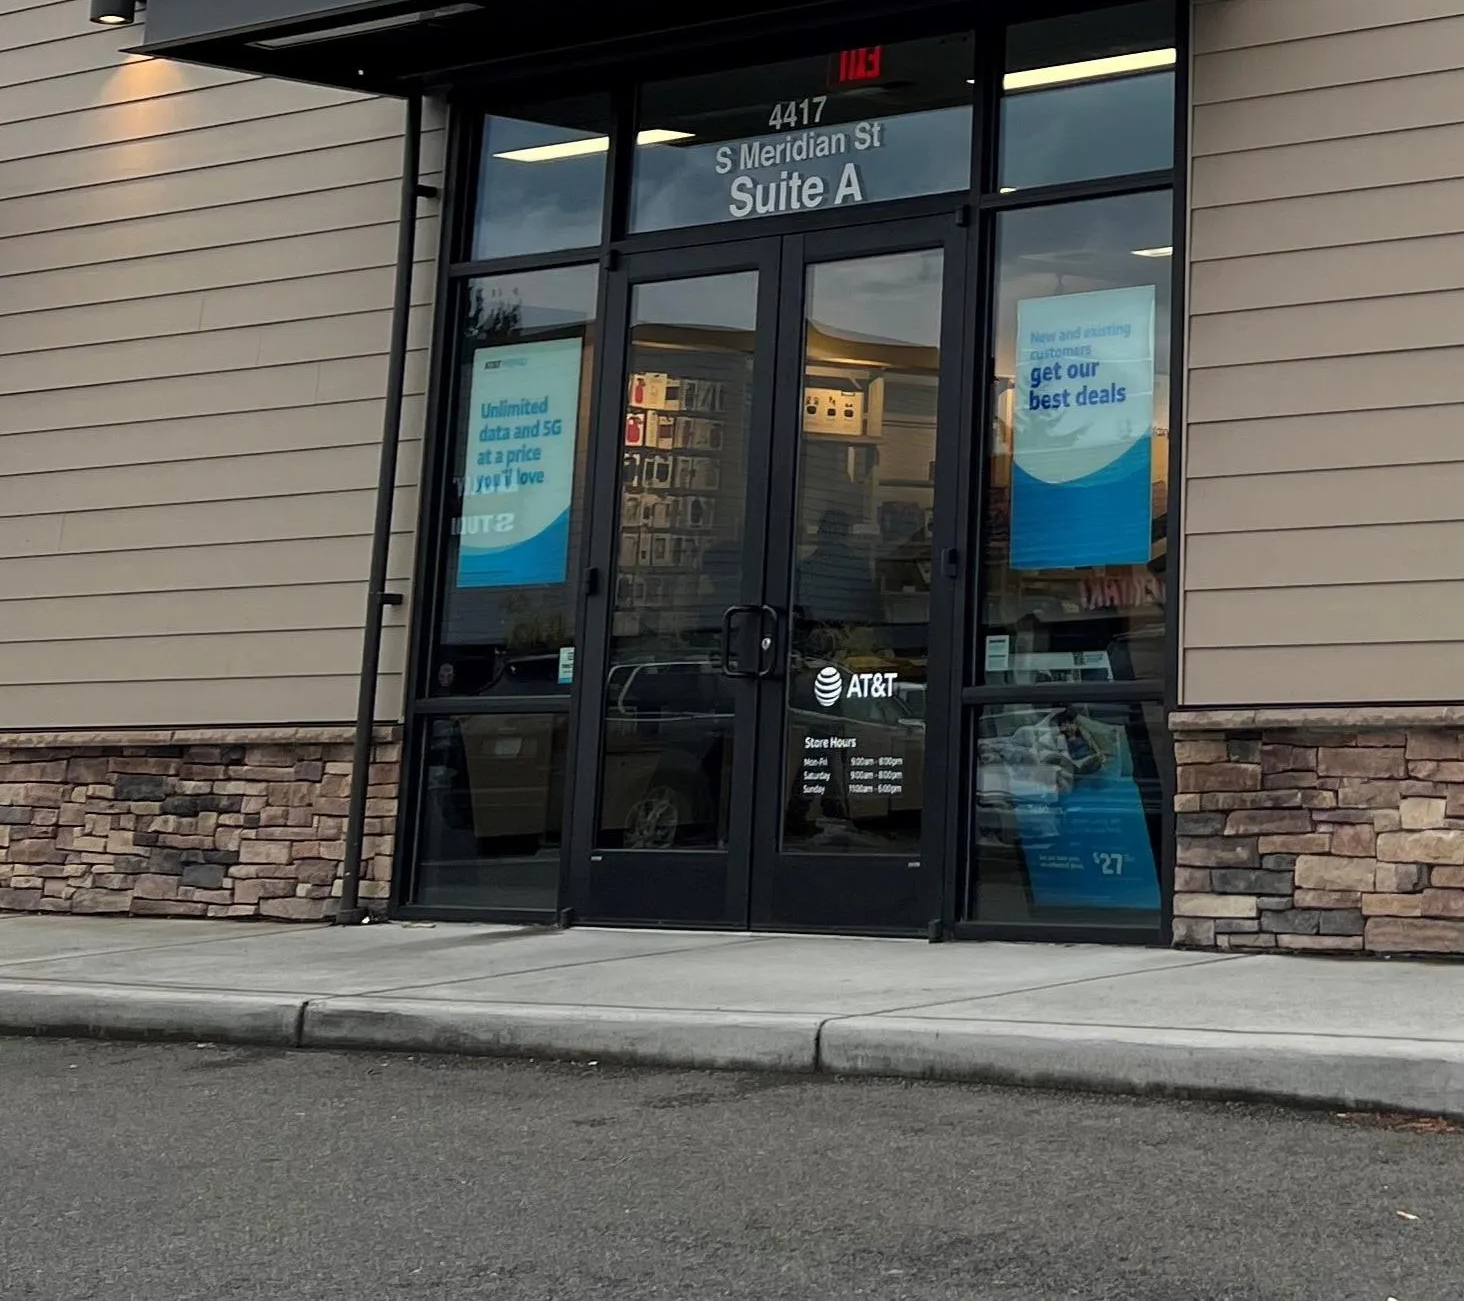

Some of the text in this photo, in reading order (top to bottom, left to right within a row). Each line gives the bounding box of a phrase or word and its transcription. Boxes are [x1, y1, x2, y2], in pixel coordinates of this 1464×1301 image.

[769, 95, 827, 130] 4417
[715, 121, 881, 174] S Meridian St
[729, 162, 863, 217] Suite A
[1030, 324, 1131, 344] New and existing
[1030, 345, 1092, 360] customers
[1030, 361, 1100, 388] get our
[481, 396, 548, 419] Unlimited
[1029, 382, 1127, 410] best deals
[479, 419, 562, 442] data and 5G
[477, 444, 541, 467] at a price
[517, 467, 545, 485] love
[846, 672, 898, 698] AT&T
[804, 736, 857, 749] Store Hours
[803, 771, 831, 782] Saturday
[803, 784, 826, 796] Sunday
